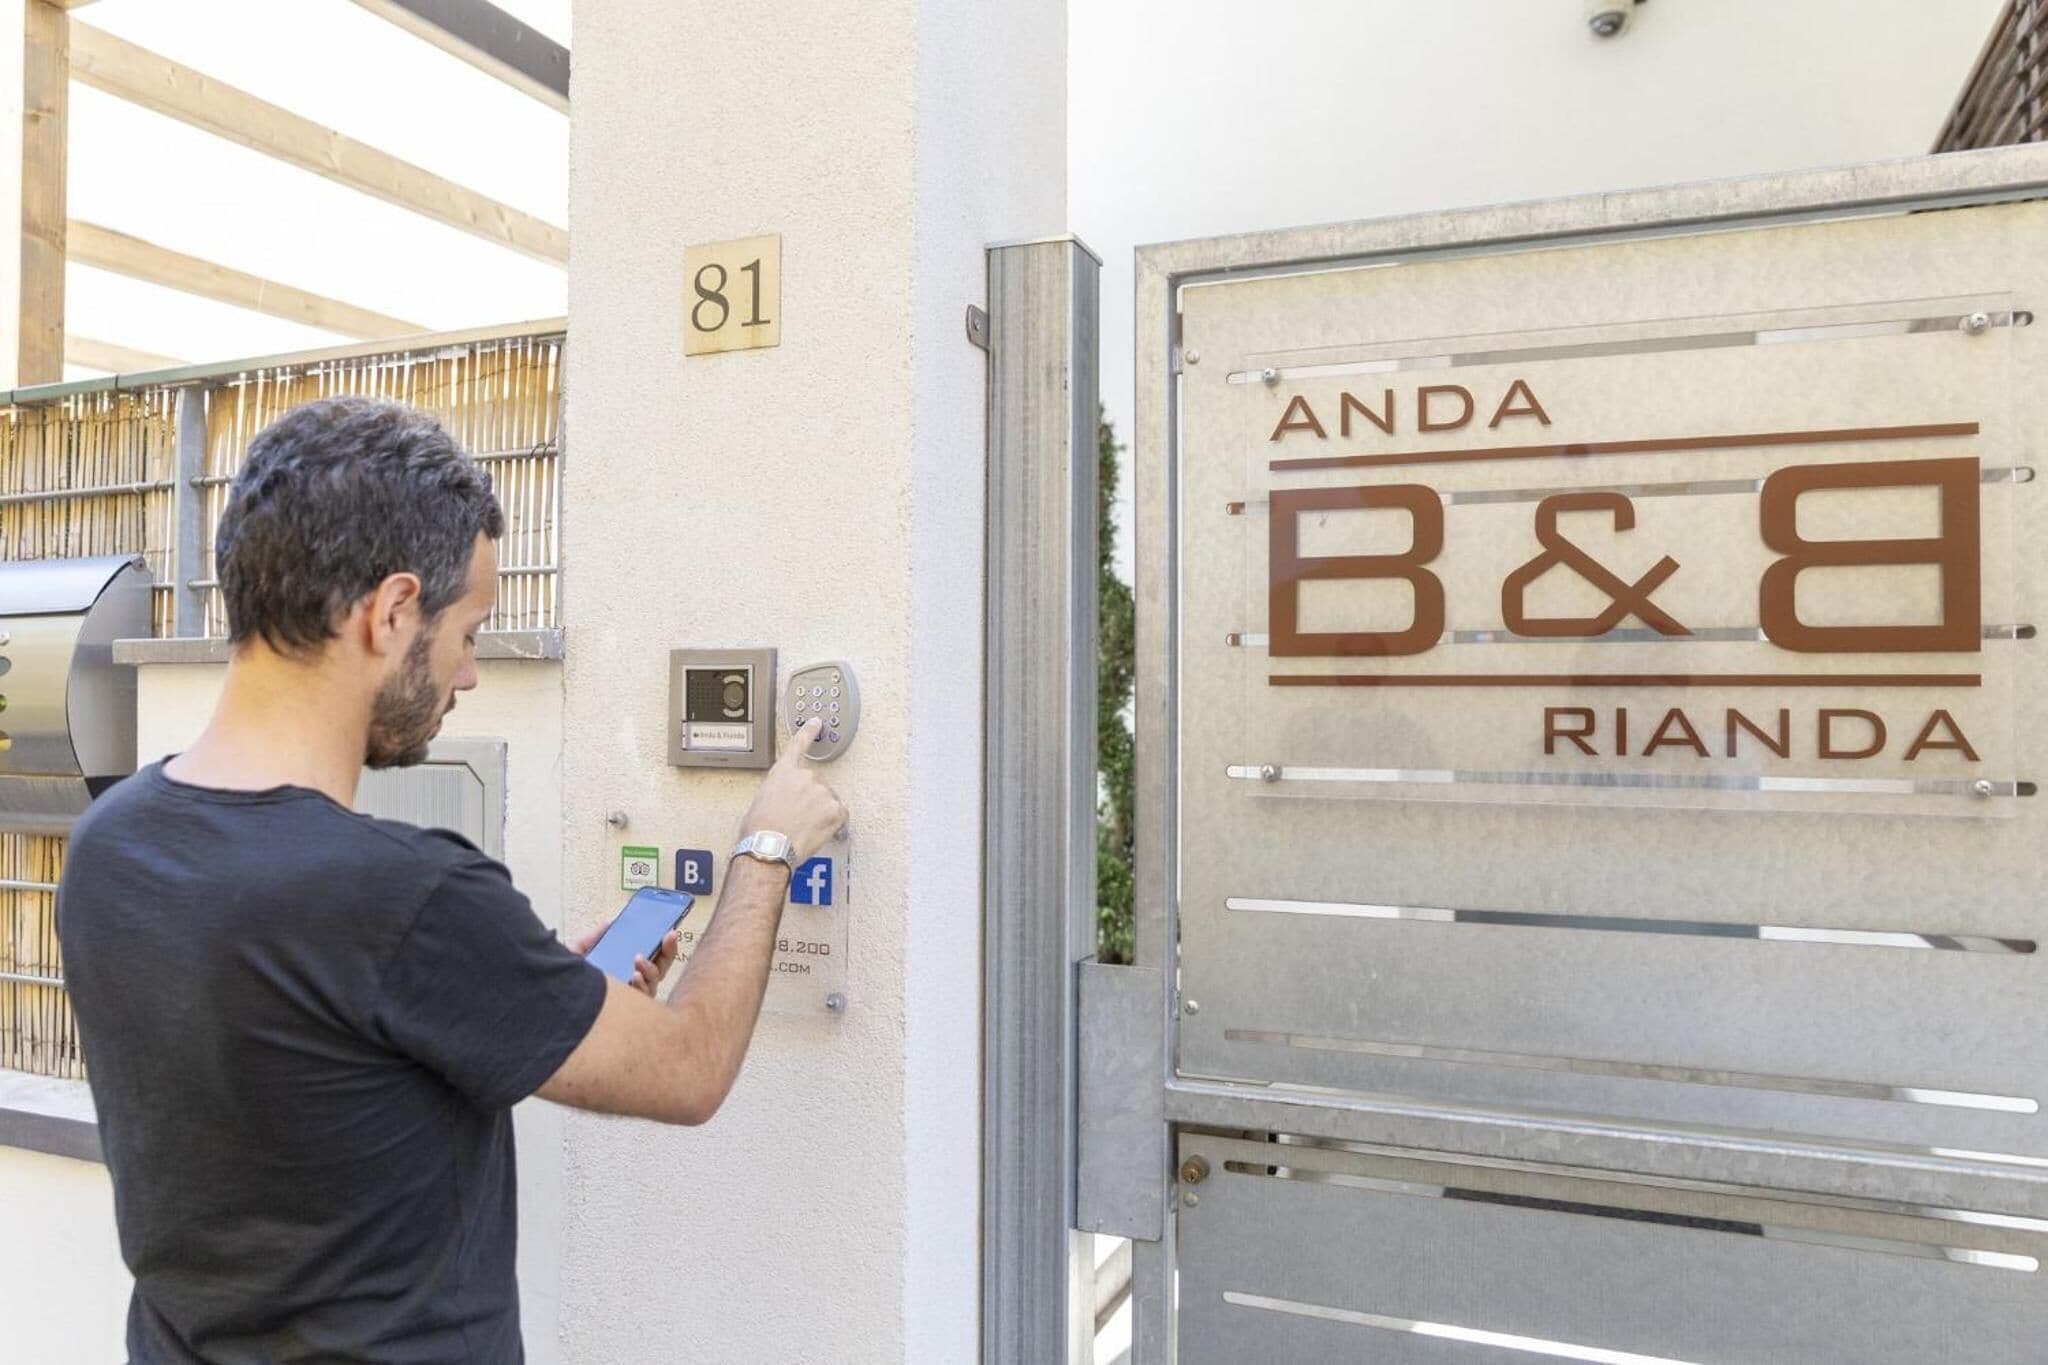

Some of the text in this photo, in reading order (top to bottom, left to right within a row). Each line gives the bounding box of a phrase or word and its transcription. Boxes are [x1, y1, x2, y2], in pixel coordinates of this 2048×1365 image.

[691, 258, 771, 333] 81
[1269, 378, 1552, 442] ANDA
[1543, 706, 1981, 762] RIANDA
[772, 961, 811, 975] .COM
[775, 940, 830, 956] 8.200
